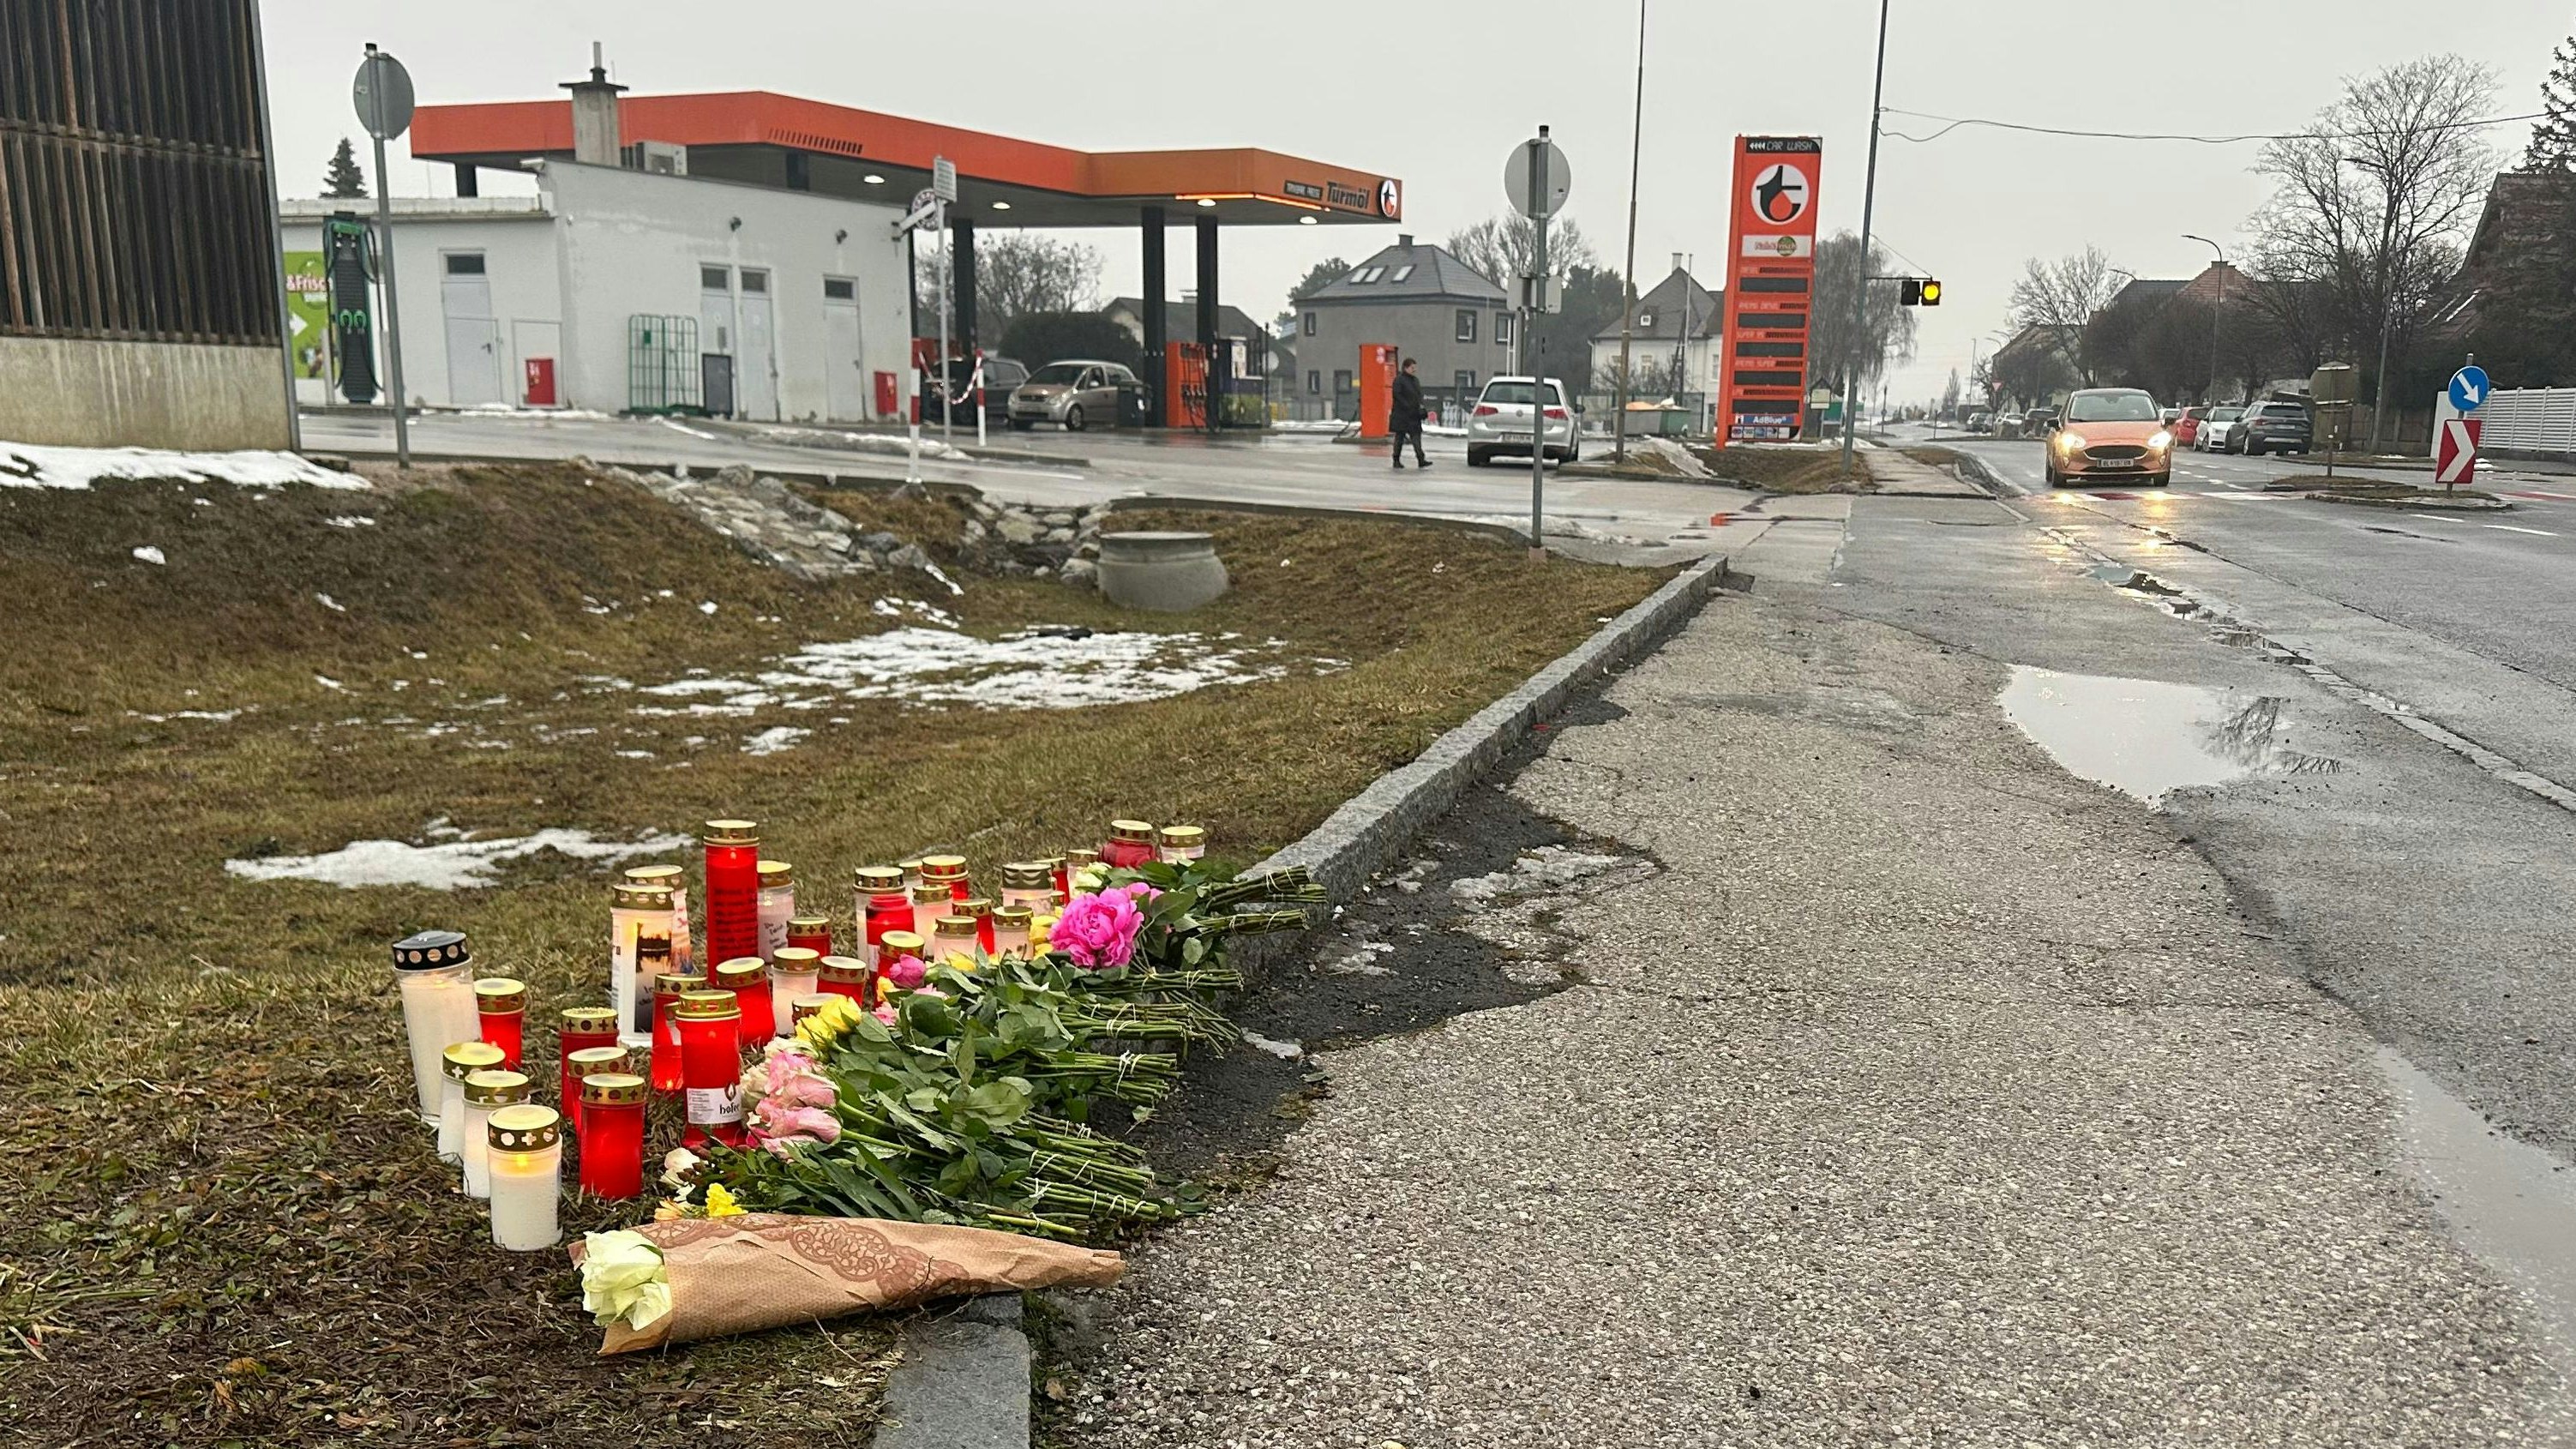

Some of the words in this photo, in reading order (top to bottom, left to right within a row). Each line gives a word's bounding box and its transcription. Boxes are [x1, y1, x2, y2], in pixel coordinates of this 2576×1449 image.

[1766, 141, 1783, 151] CAR
[1786, 141, 1812, 151] WASH
[1327, 181, 1370, 208] Turmöl
